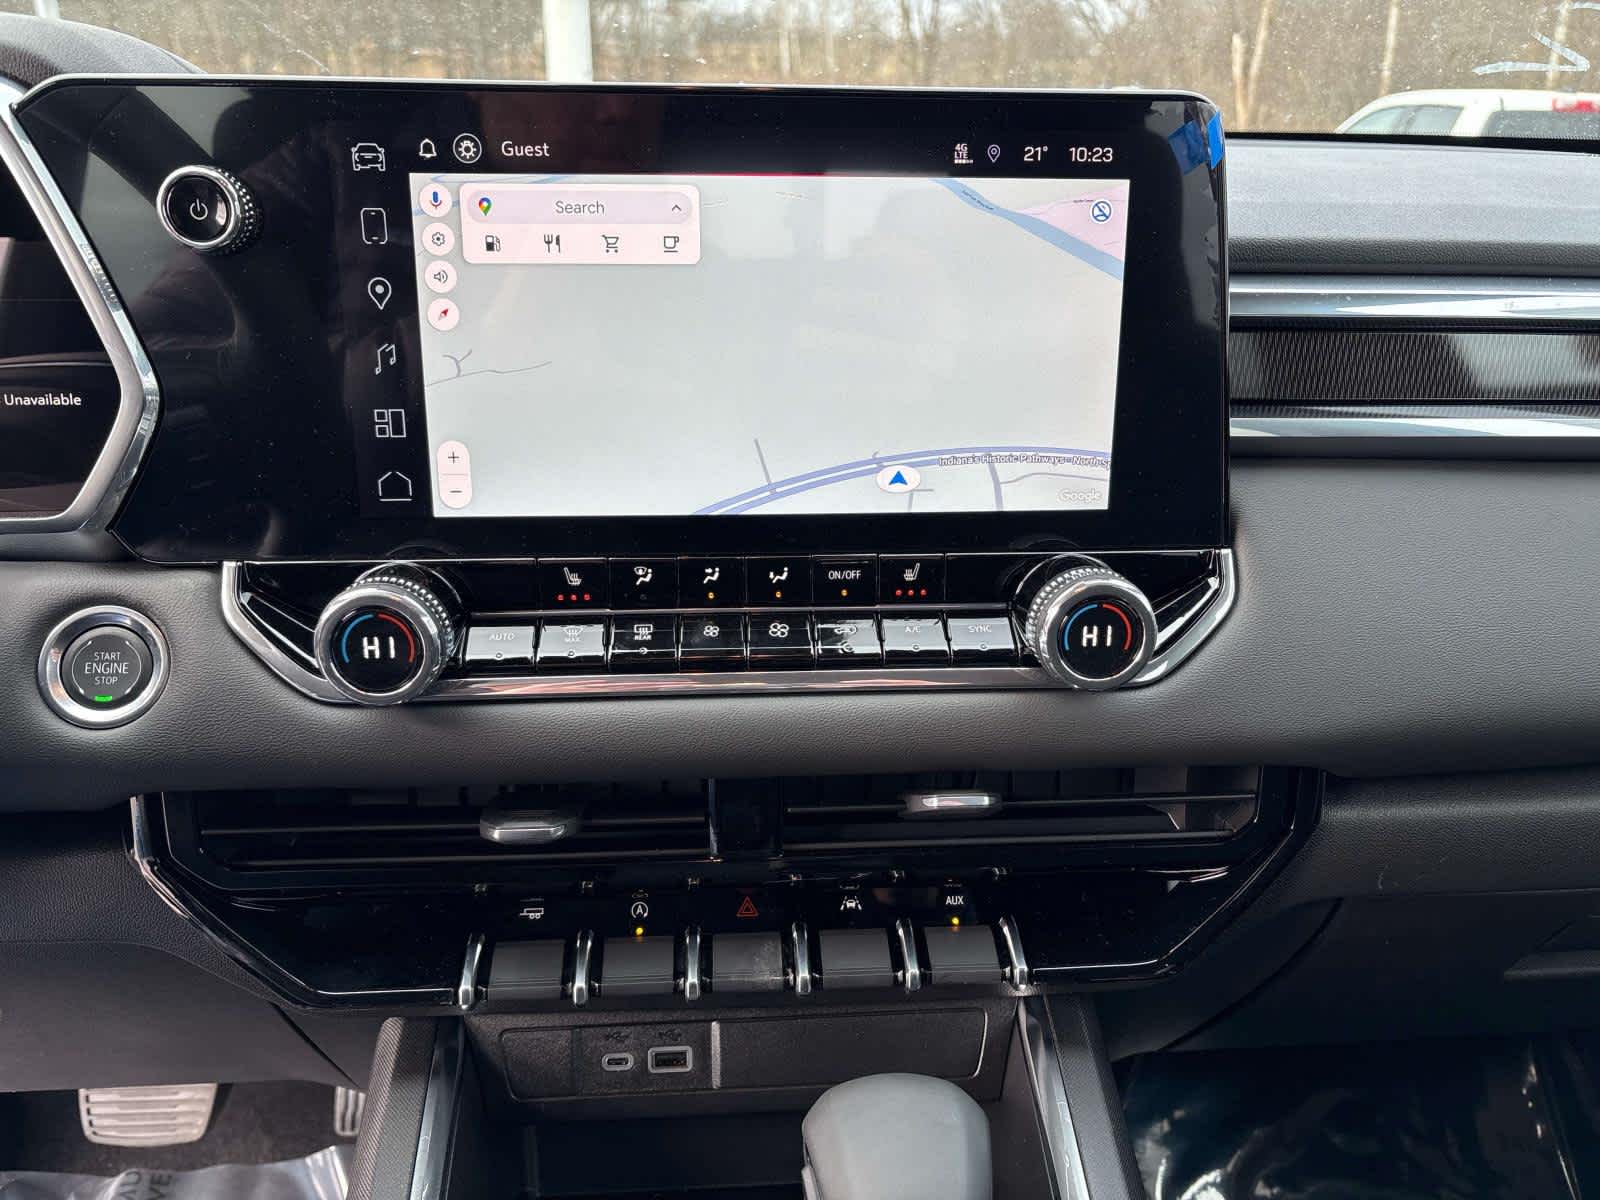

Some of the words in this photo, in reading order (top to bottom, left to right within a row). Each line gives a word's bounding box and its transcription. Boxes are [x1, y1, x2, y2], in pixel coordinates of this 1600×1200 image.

[500, 140, 551, 157] Guest
[954, 143, 969, 152] 4G
[954, 151, 969, 159] LTE
[1068, 147, 1114, 163] 10:23
[554, 199, 606, 215] Search
[3, 392, 82, 406] Unavailable
[938, 454, 980, 466] Indiana's
[1058, 488, 1104, 505] Google
[827, 569, 862, 581] ON/OFF
[904, 625, 921, 633] A/C
[967, 625, 992, 634] SYNC
[488, 632, 516, 642] AUTO
[1081, 624, 1113, 648] HI
[362, 635, 396, 660] HI
[94, 651, 121, 661] START
[84, 662, 129, 674] ENGINE
[94, 675, 119, 686] STOP
[945, 895, 964, 905] AUX
